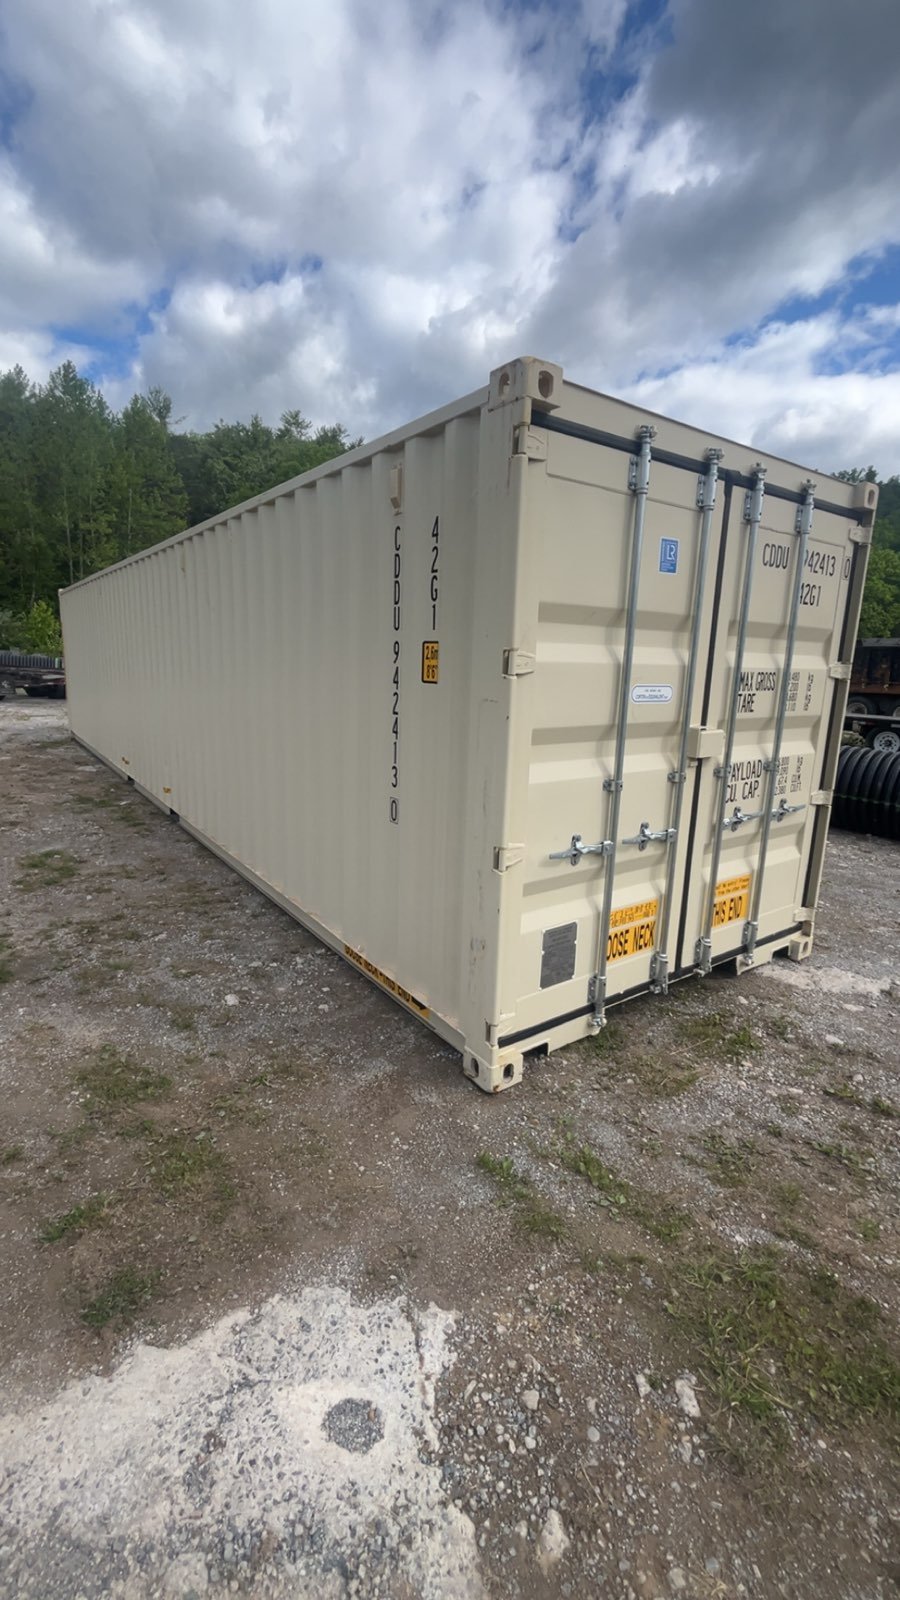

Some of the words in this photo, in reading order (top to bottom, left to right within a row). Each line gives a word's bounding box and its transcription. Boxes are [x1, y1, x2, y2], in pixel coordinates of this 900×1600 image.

[762, 543, 790, 570] CDDU
[431, 516, 439, 630] 42G1
[739, 672, 754, 691] MAX
[755, 672, 776, 691] GROSS
[391, 641, 400, 788] 942413
[738, 693, 756, 713] TARE
[728, 895, 742, 921] END
[633, 921, 656, 953] NECK
